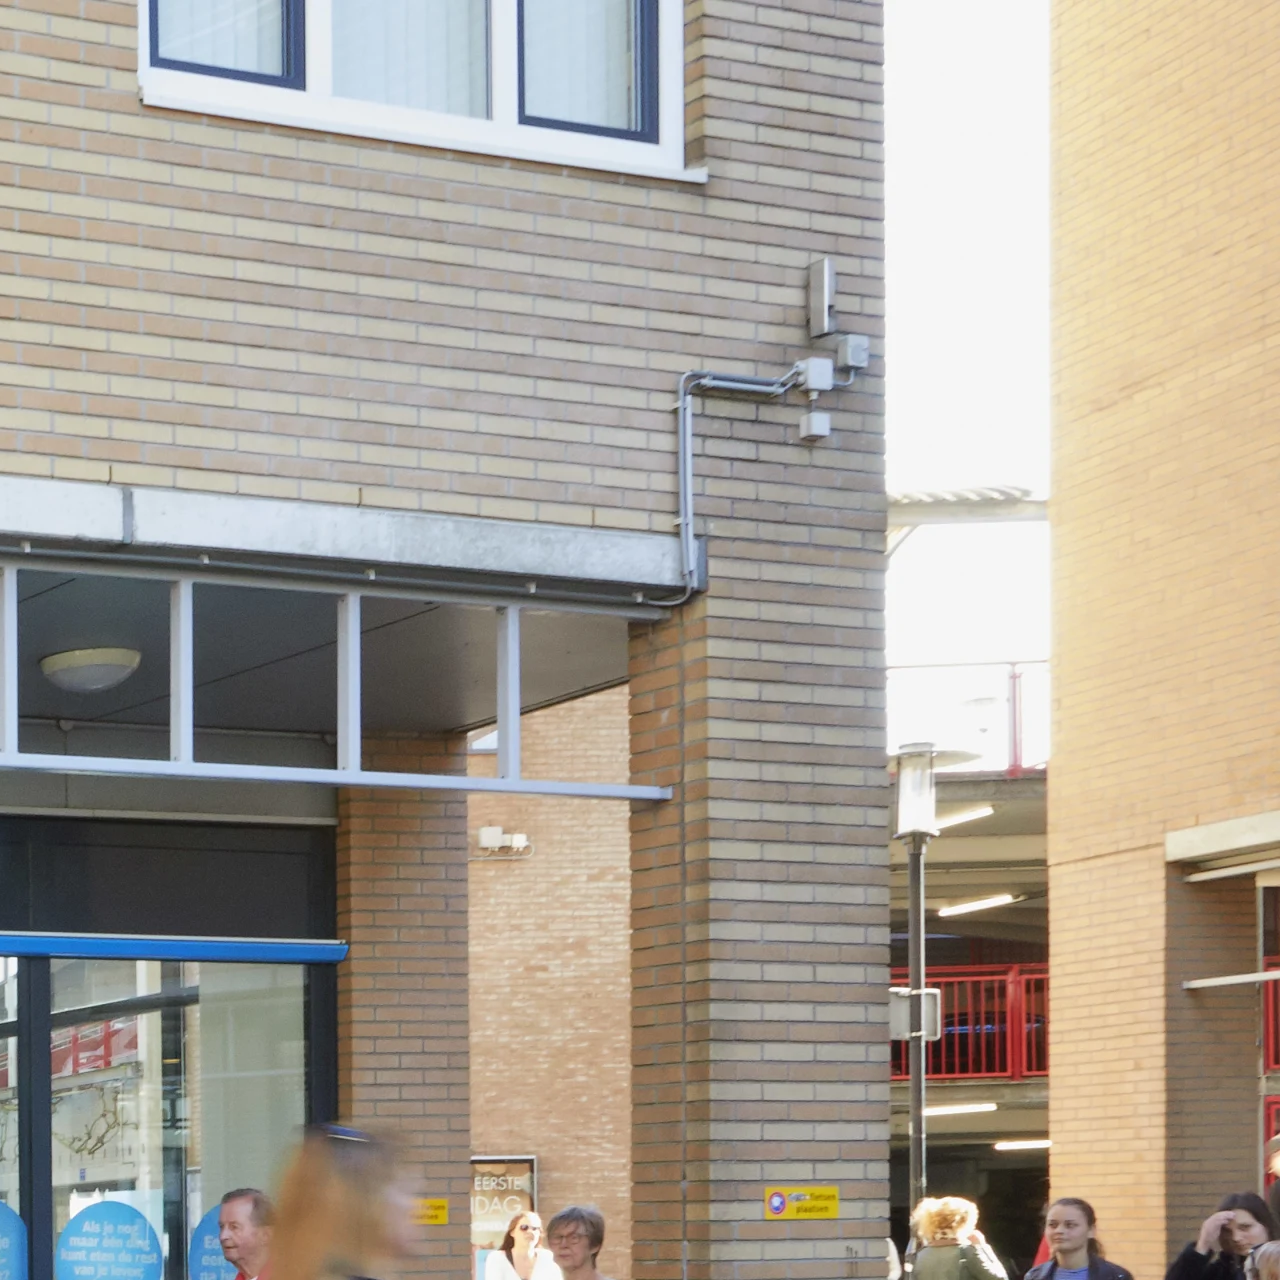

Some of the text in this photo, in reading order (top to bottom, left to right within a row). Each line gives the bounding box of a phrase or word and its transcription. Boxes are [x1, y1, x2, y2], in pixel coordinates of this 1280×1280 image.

[474, 1176, 521, 1191] EERSTE
[470, 1196, 522, 1215] DAG
[82, 1221, 139, 1239] Als je nog
[69, 1236, 98, 1248] maar
[61, 1249, 158, 1264] kunt eten de rest
[73, 1265, 96, 1276] van
[98, 1264, 108, 1279] je
